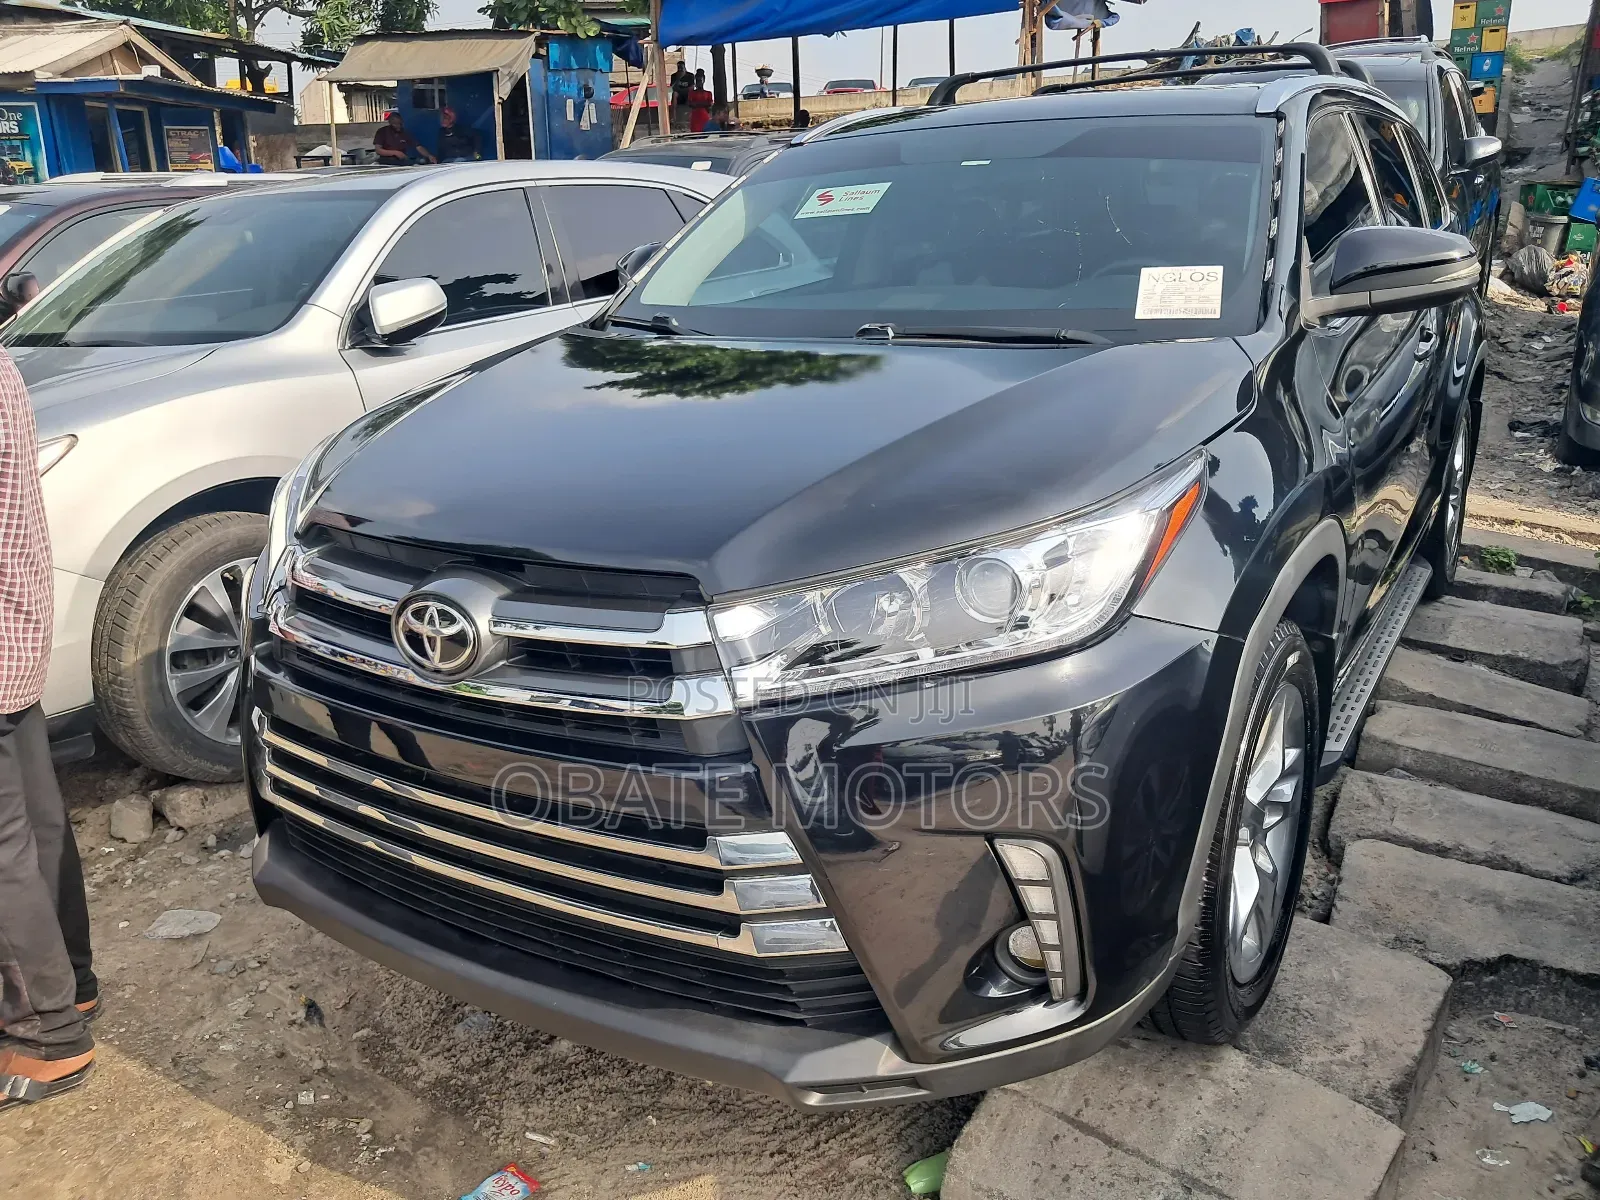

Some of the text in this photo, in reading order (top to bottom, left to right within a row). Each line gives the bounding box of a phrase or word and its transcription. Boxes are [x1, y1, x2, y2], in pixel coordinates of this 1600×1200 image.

[0, 121, 19, 133] RS
[842, 189, 880, 197] Sallaum
[1147, 271, 1219, 283] NGLOS
